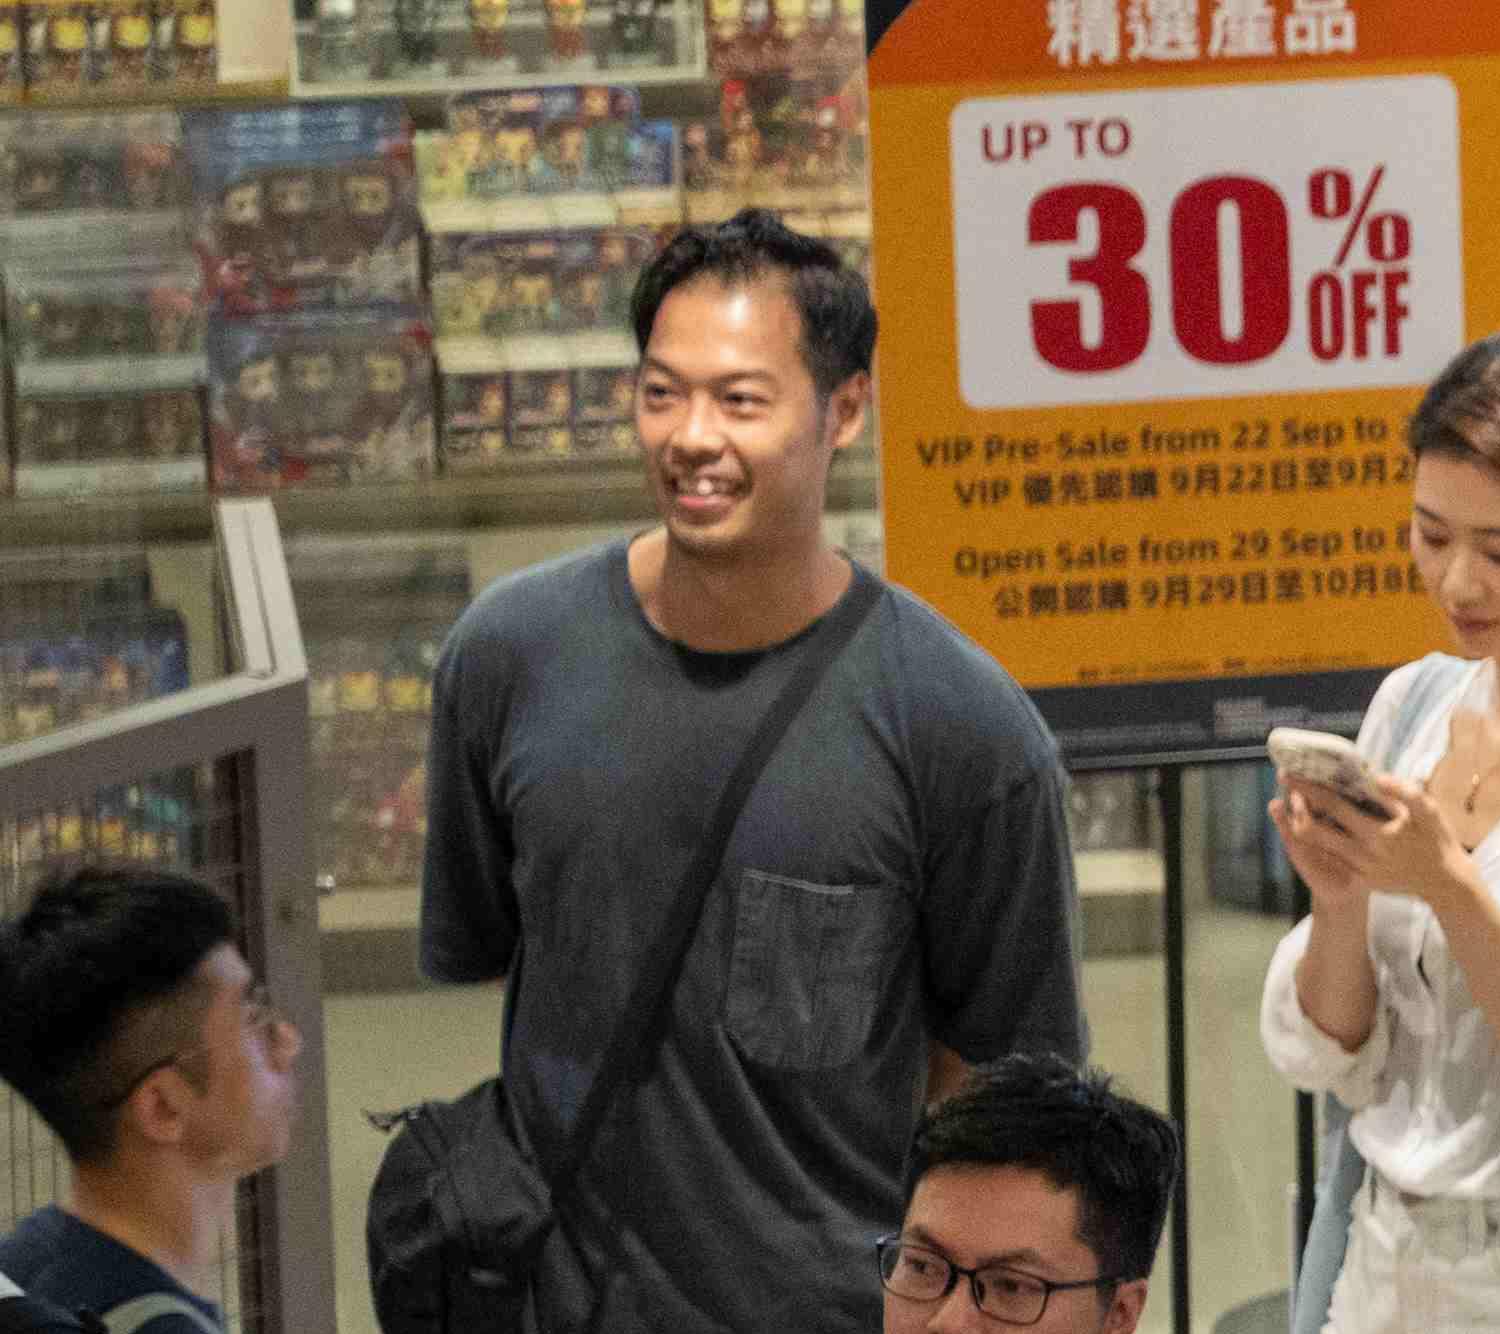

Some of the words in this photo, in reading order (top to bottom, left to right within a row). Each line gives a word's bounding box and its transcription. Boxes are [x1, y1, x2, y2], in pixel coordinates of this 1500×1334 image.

[981, 122, 1048, 163] UP
[1066, 118, 1131, 159] TO
[1027, 165, 1411, 375] 30%
[1308, 270, 1410, 361] OFF
[916, 436, 972, 467] VIP
[1140, 424, 1221, 456] from
[1231, 420, 1270, 450] 22
[1281, 418, 1344, 454] Sep
[1354, 416, 1388, 441] to
[955, 480, 1010, 508] VIP
[953, 546, 1046, 580] Open
[1056, 538, 1129, 569] Sale
[1138, 533, 1219, 565] from
[1280, 526, 1344, 560] Sep
[1352, 524, 1386, 552] to
